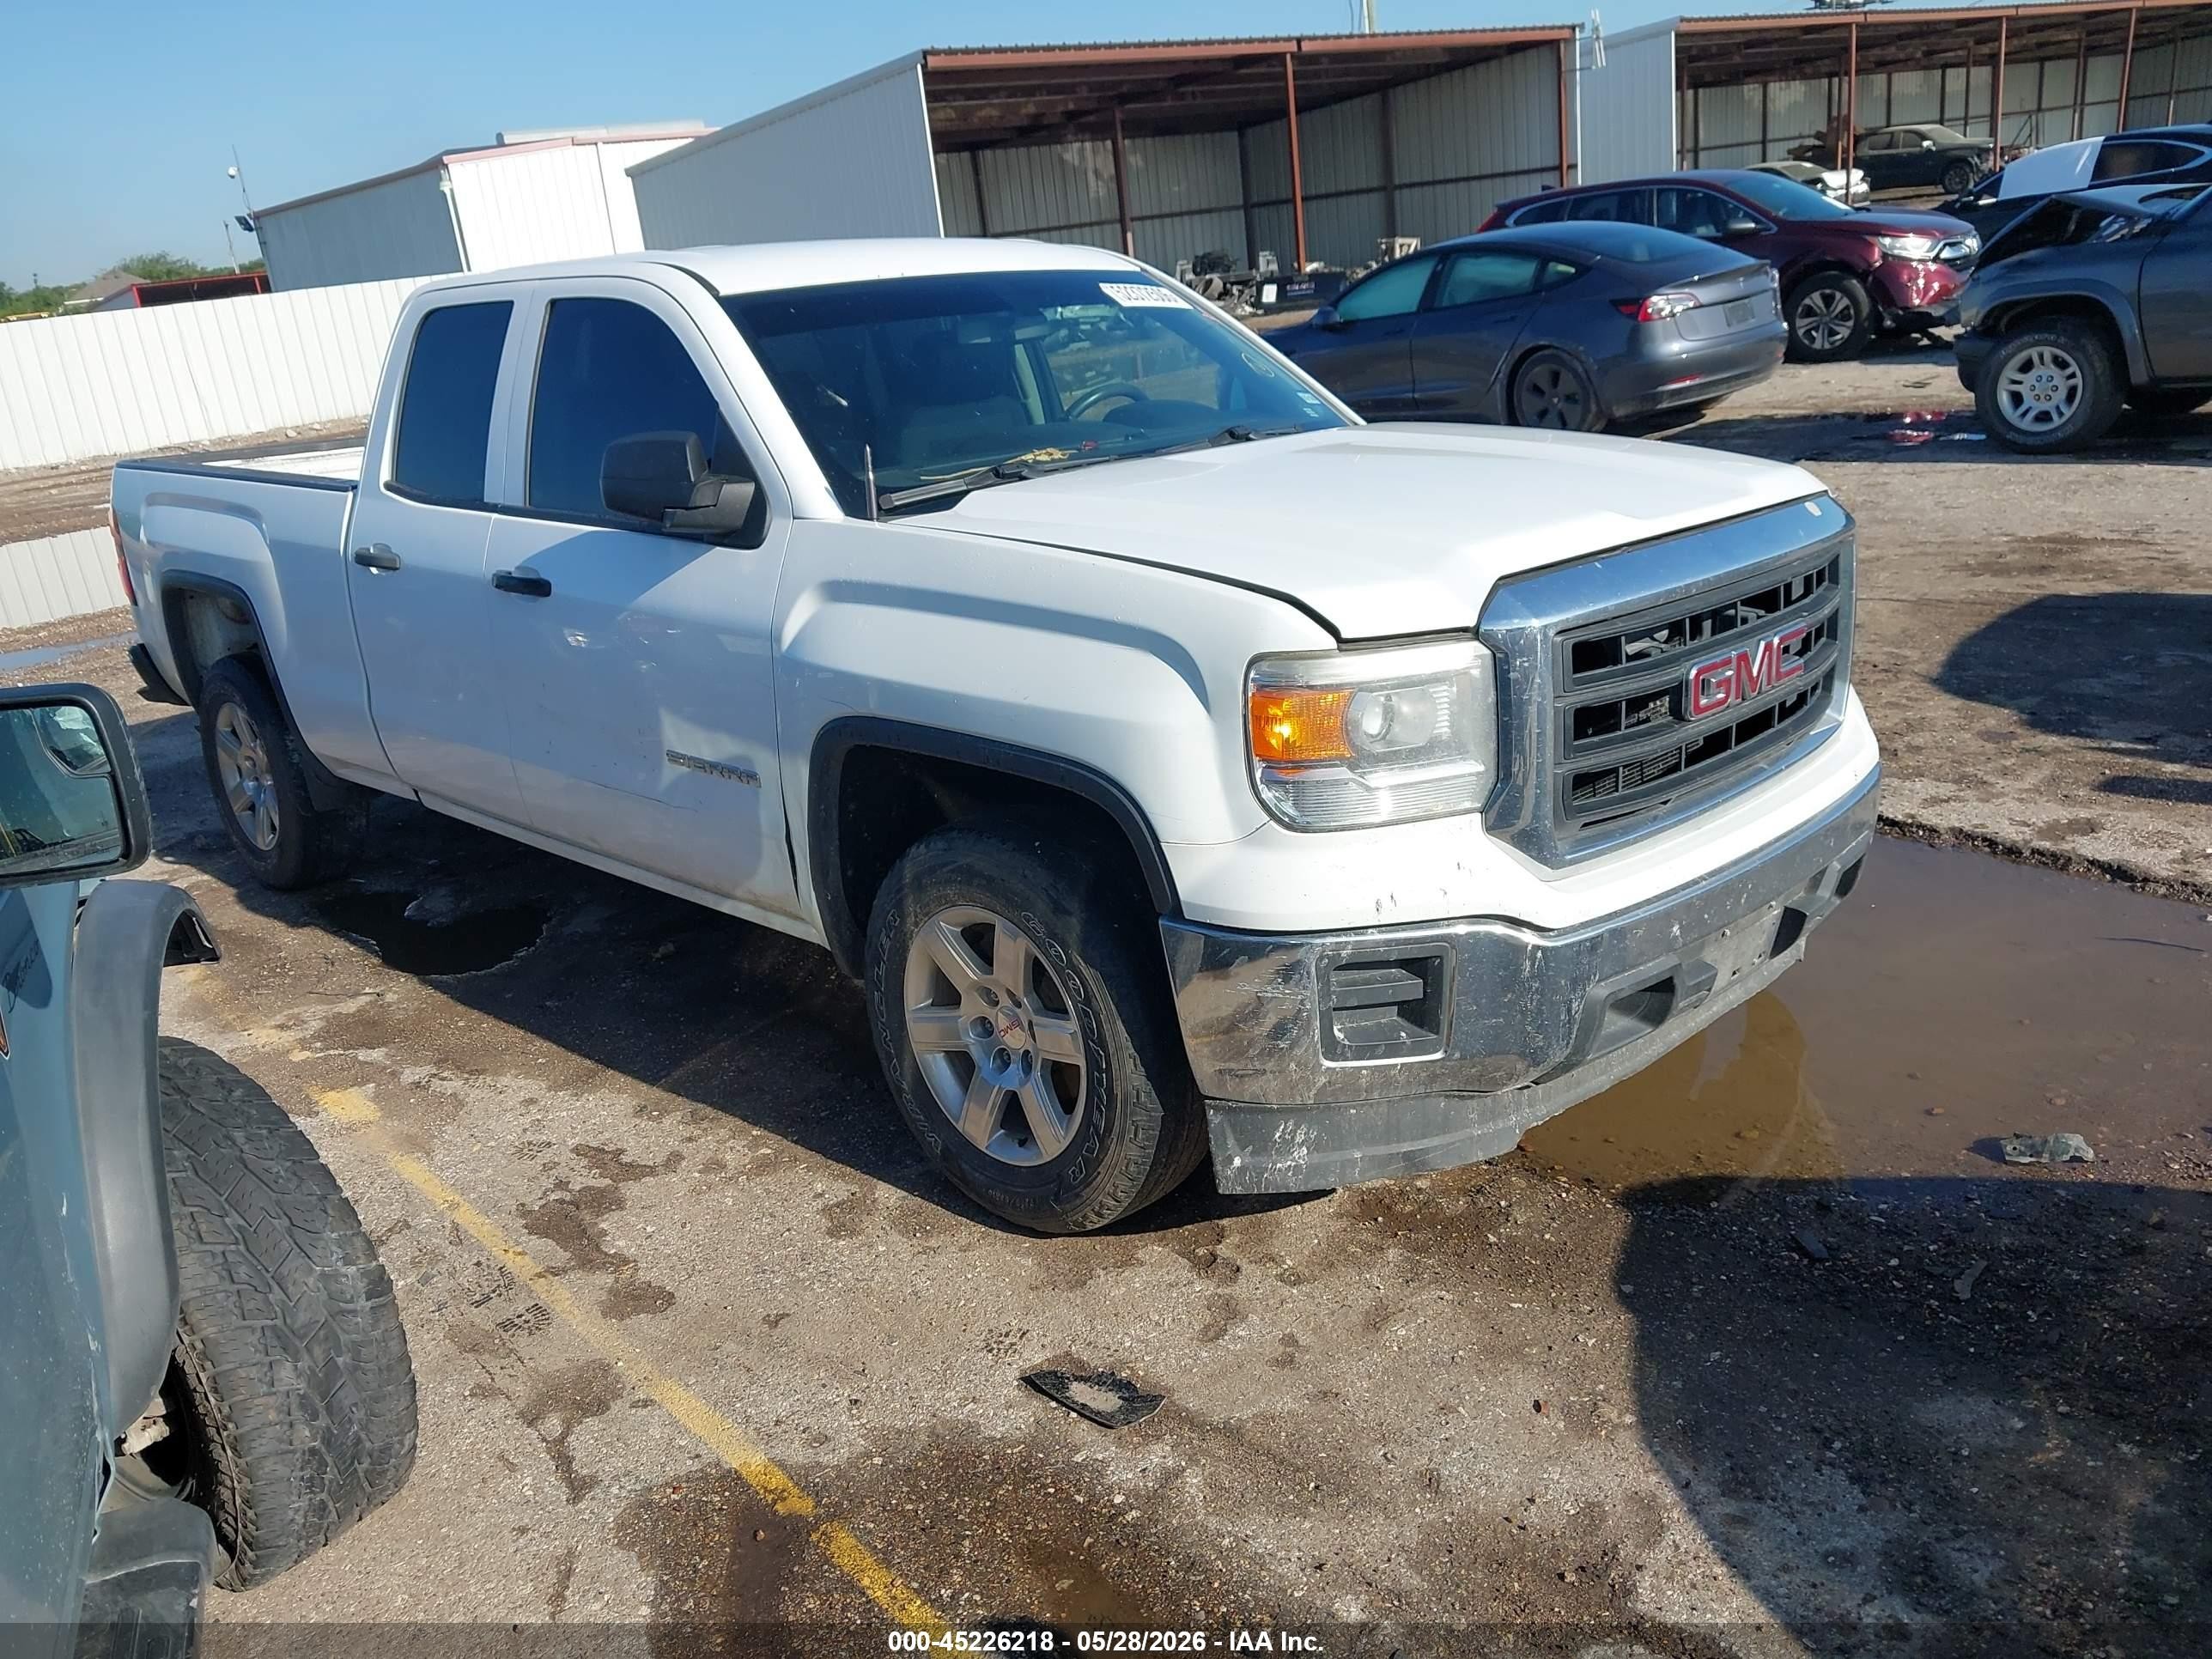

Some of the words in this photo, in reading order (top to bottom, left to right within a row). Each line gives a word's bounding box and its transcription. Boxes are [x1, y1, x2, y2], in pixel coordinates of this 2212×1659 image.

[1689, 619, 1808, 720] GMC
[666, 749, 763, 789] SIERRA
[873, 909, 943, 1155] WRANGLER
[999, 1017, 1021, 1038] GMC
[1021, 911, 1109, 1183] GOODYEAR
